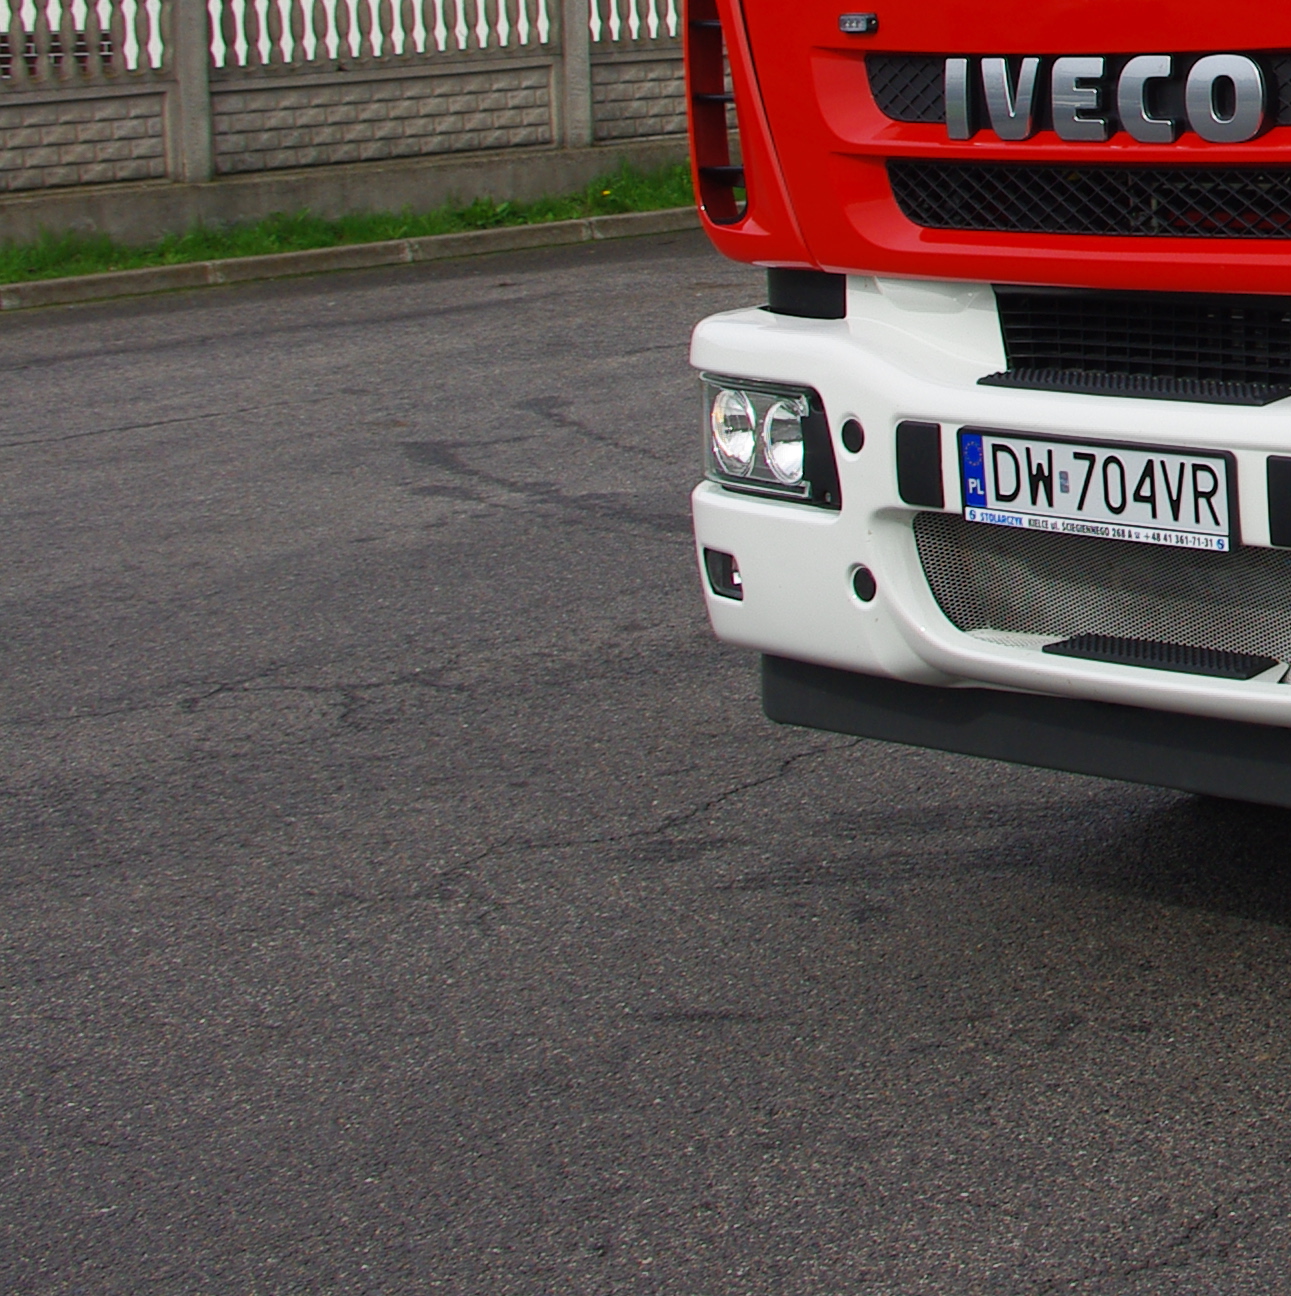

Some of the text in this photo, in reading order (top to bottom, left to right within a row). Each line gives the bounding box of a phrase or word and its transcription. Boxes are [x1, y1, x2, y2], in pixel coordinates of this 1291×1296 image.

[945, 54, 1267, 143] IVECO
[968, 478, 985, 495] PL
[991, 443, 1222, 527] DW 704VR
[980, 512, 1023, 527] STOLARCZYK
[1028, 518, 1049, 530] KIELCE
[1111, 527, 1126, 538] 268
[1163, 533, 1173, 544] 41
